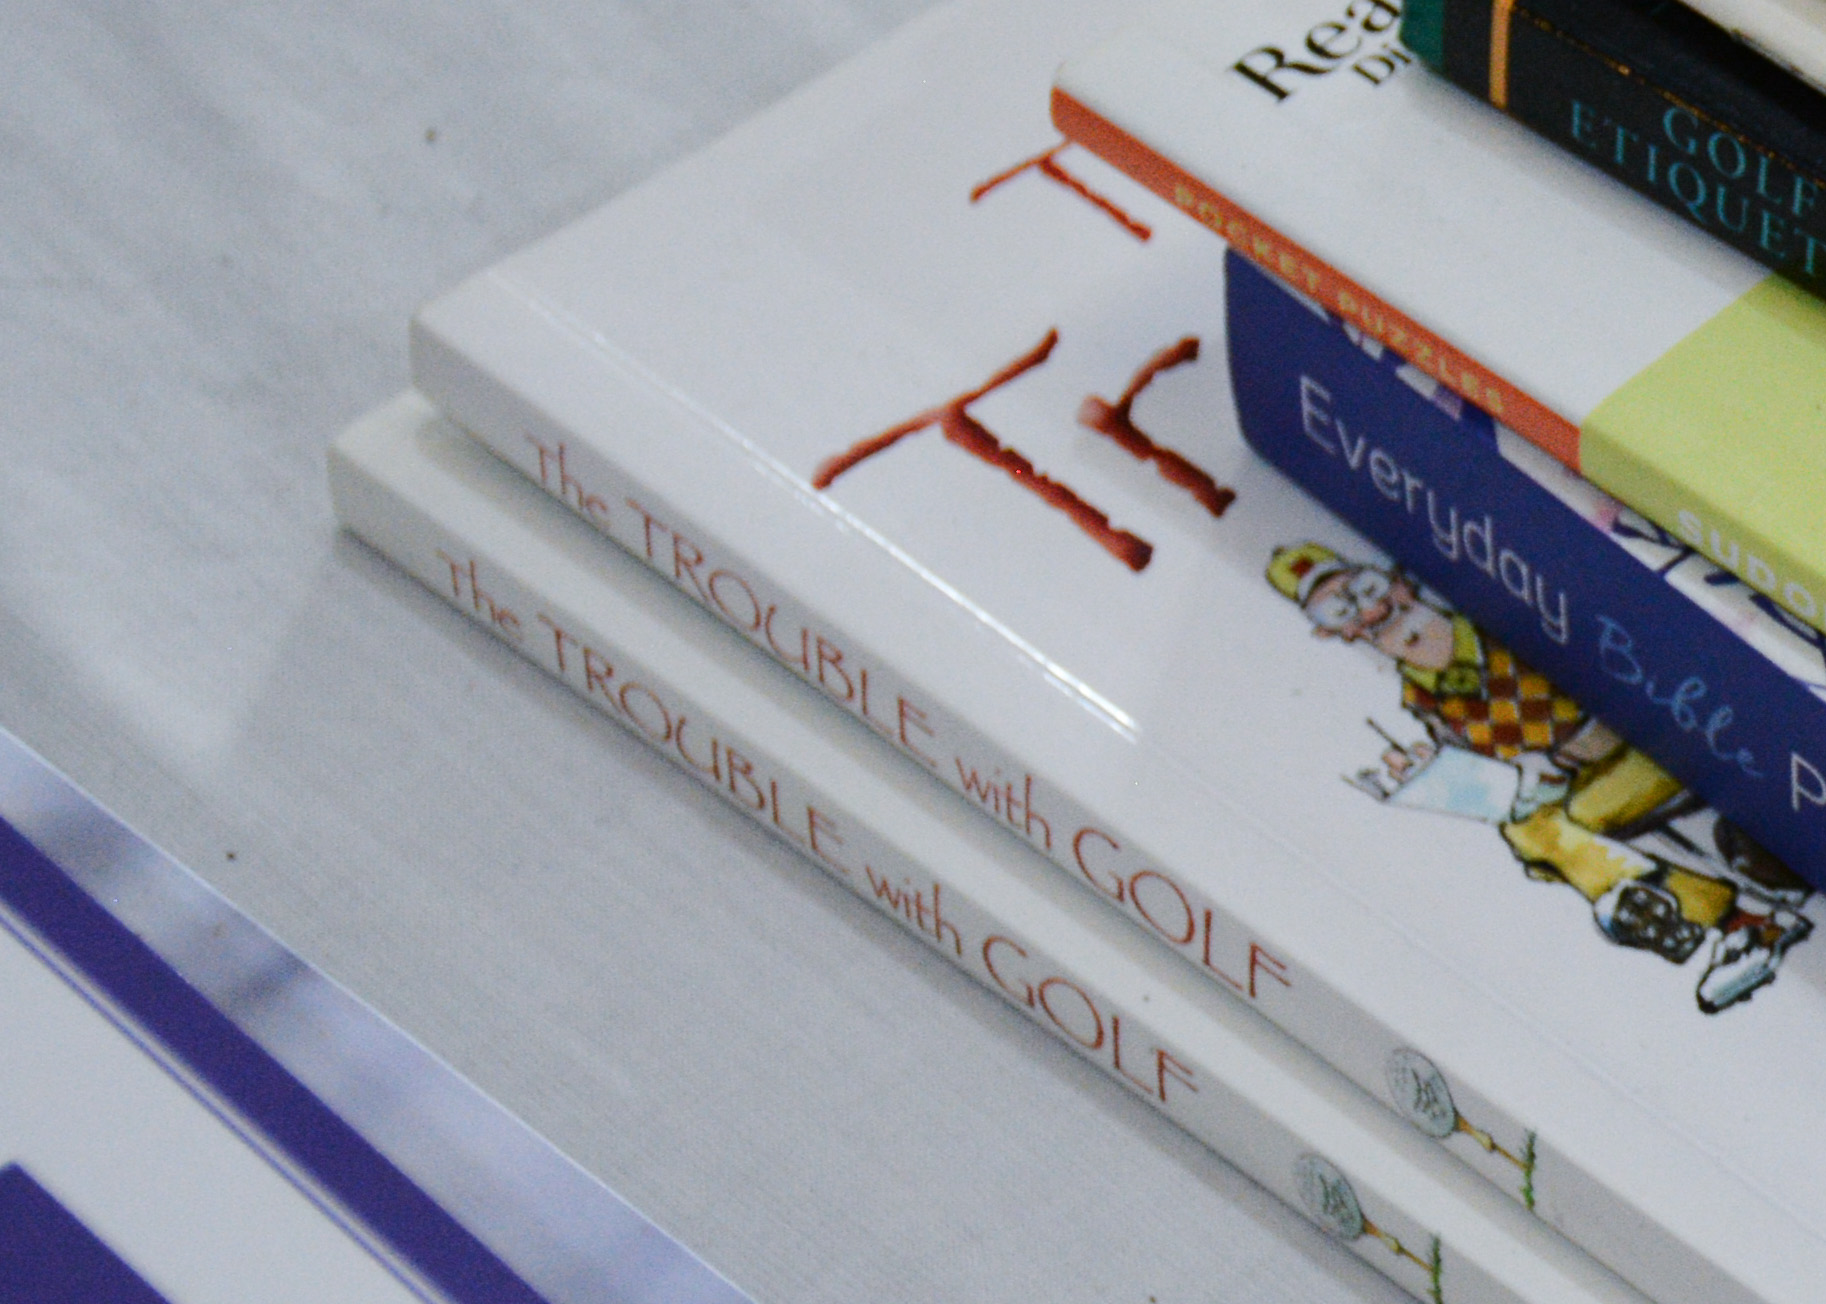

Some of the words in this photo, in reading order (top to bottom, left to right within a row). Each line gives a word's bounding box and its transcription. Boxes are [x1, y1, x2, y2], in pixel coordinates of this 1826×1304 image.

[1173, 182, 1321, 293] POCKET
[1336, 290, 1504, 414] PUZZLES
[1662, 105, 1821, 217] GOLF
[626, 497, 938, 767] TROUBLE
[954, 752, 1053, 852] with
[1071, 826, 1294, 1000] GOLF
[1299, 373, 1570, 644] Everyday
[1595, 613, 1764, 780] Bible
[536, 611, 852, 875] TROUBLE
[863, 861, 964, 959] with
[980, 933, 1199, 1103] GOLF
